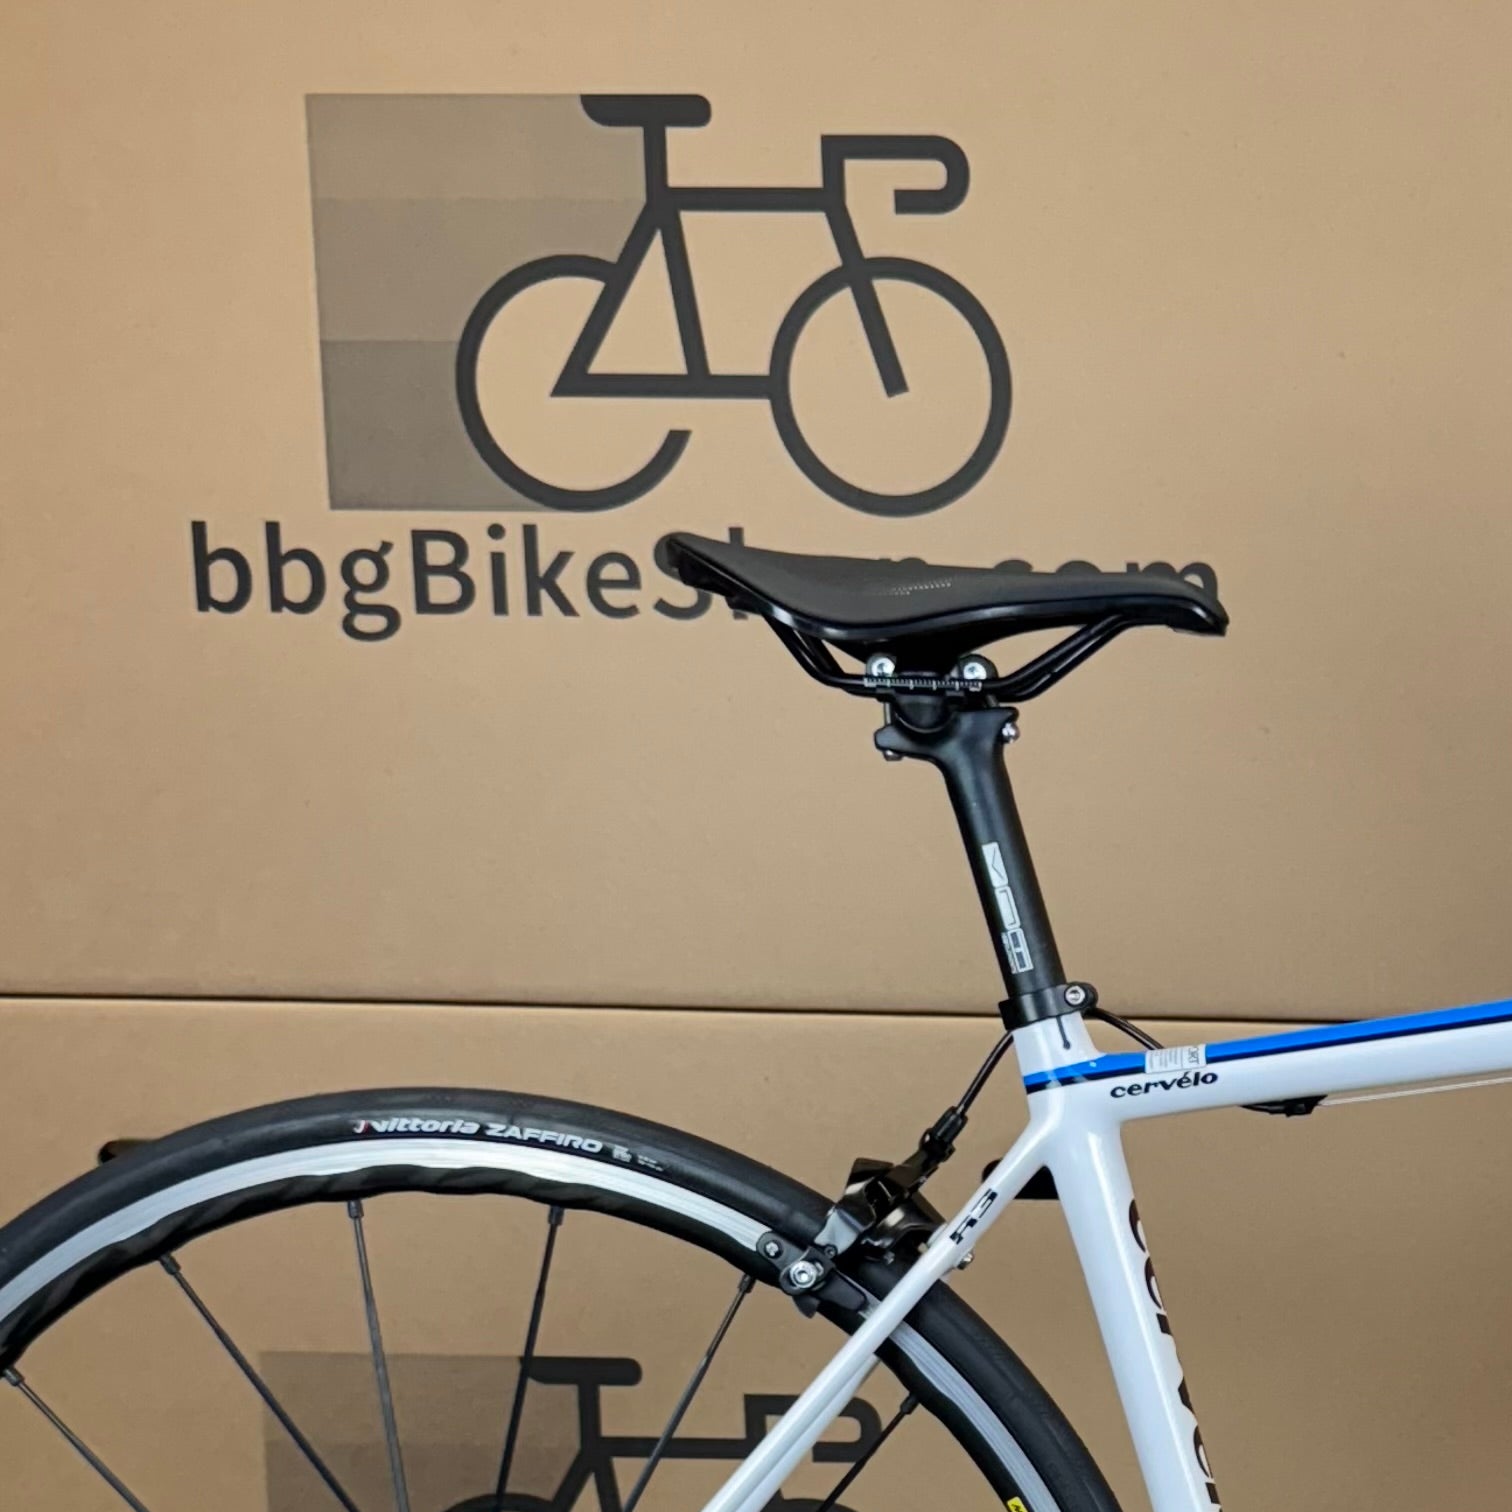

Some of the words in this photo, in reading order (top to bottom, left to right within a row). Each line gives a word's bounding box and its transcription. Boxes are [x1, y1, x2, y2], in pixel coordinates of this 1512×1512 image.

[1110, 1070, 1219, 1099] cervélo
[367, 1116, 481, 1135] vittoria
[484, 1121, 604, 1154] ZAFFIRO
[949, 1188, 998, 1245] R3
